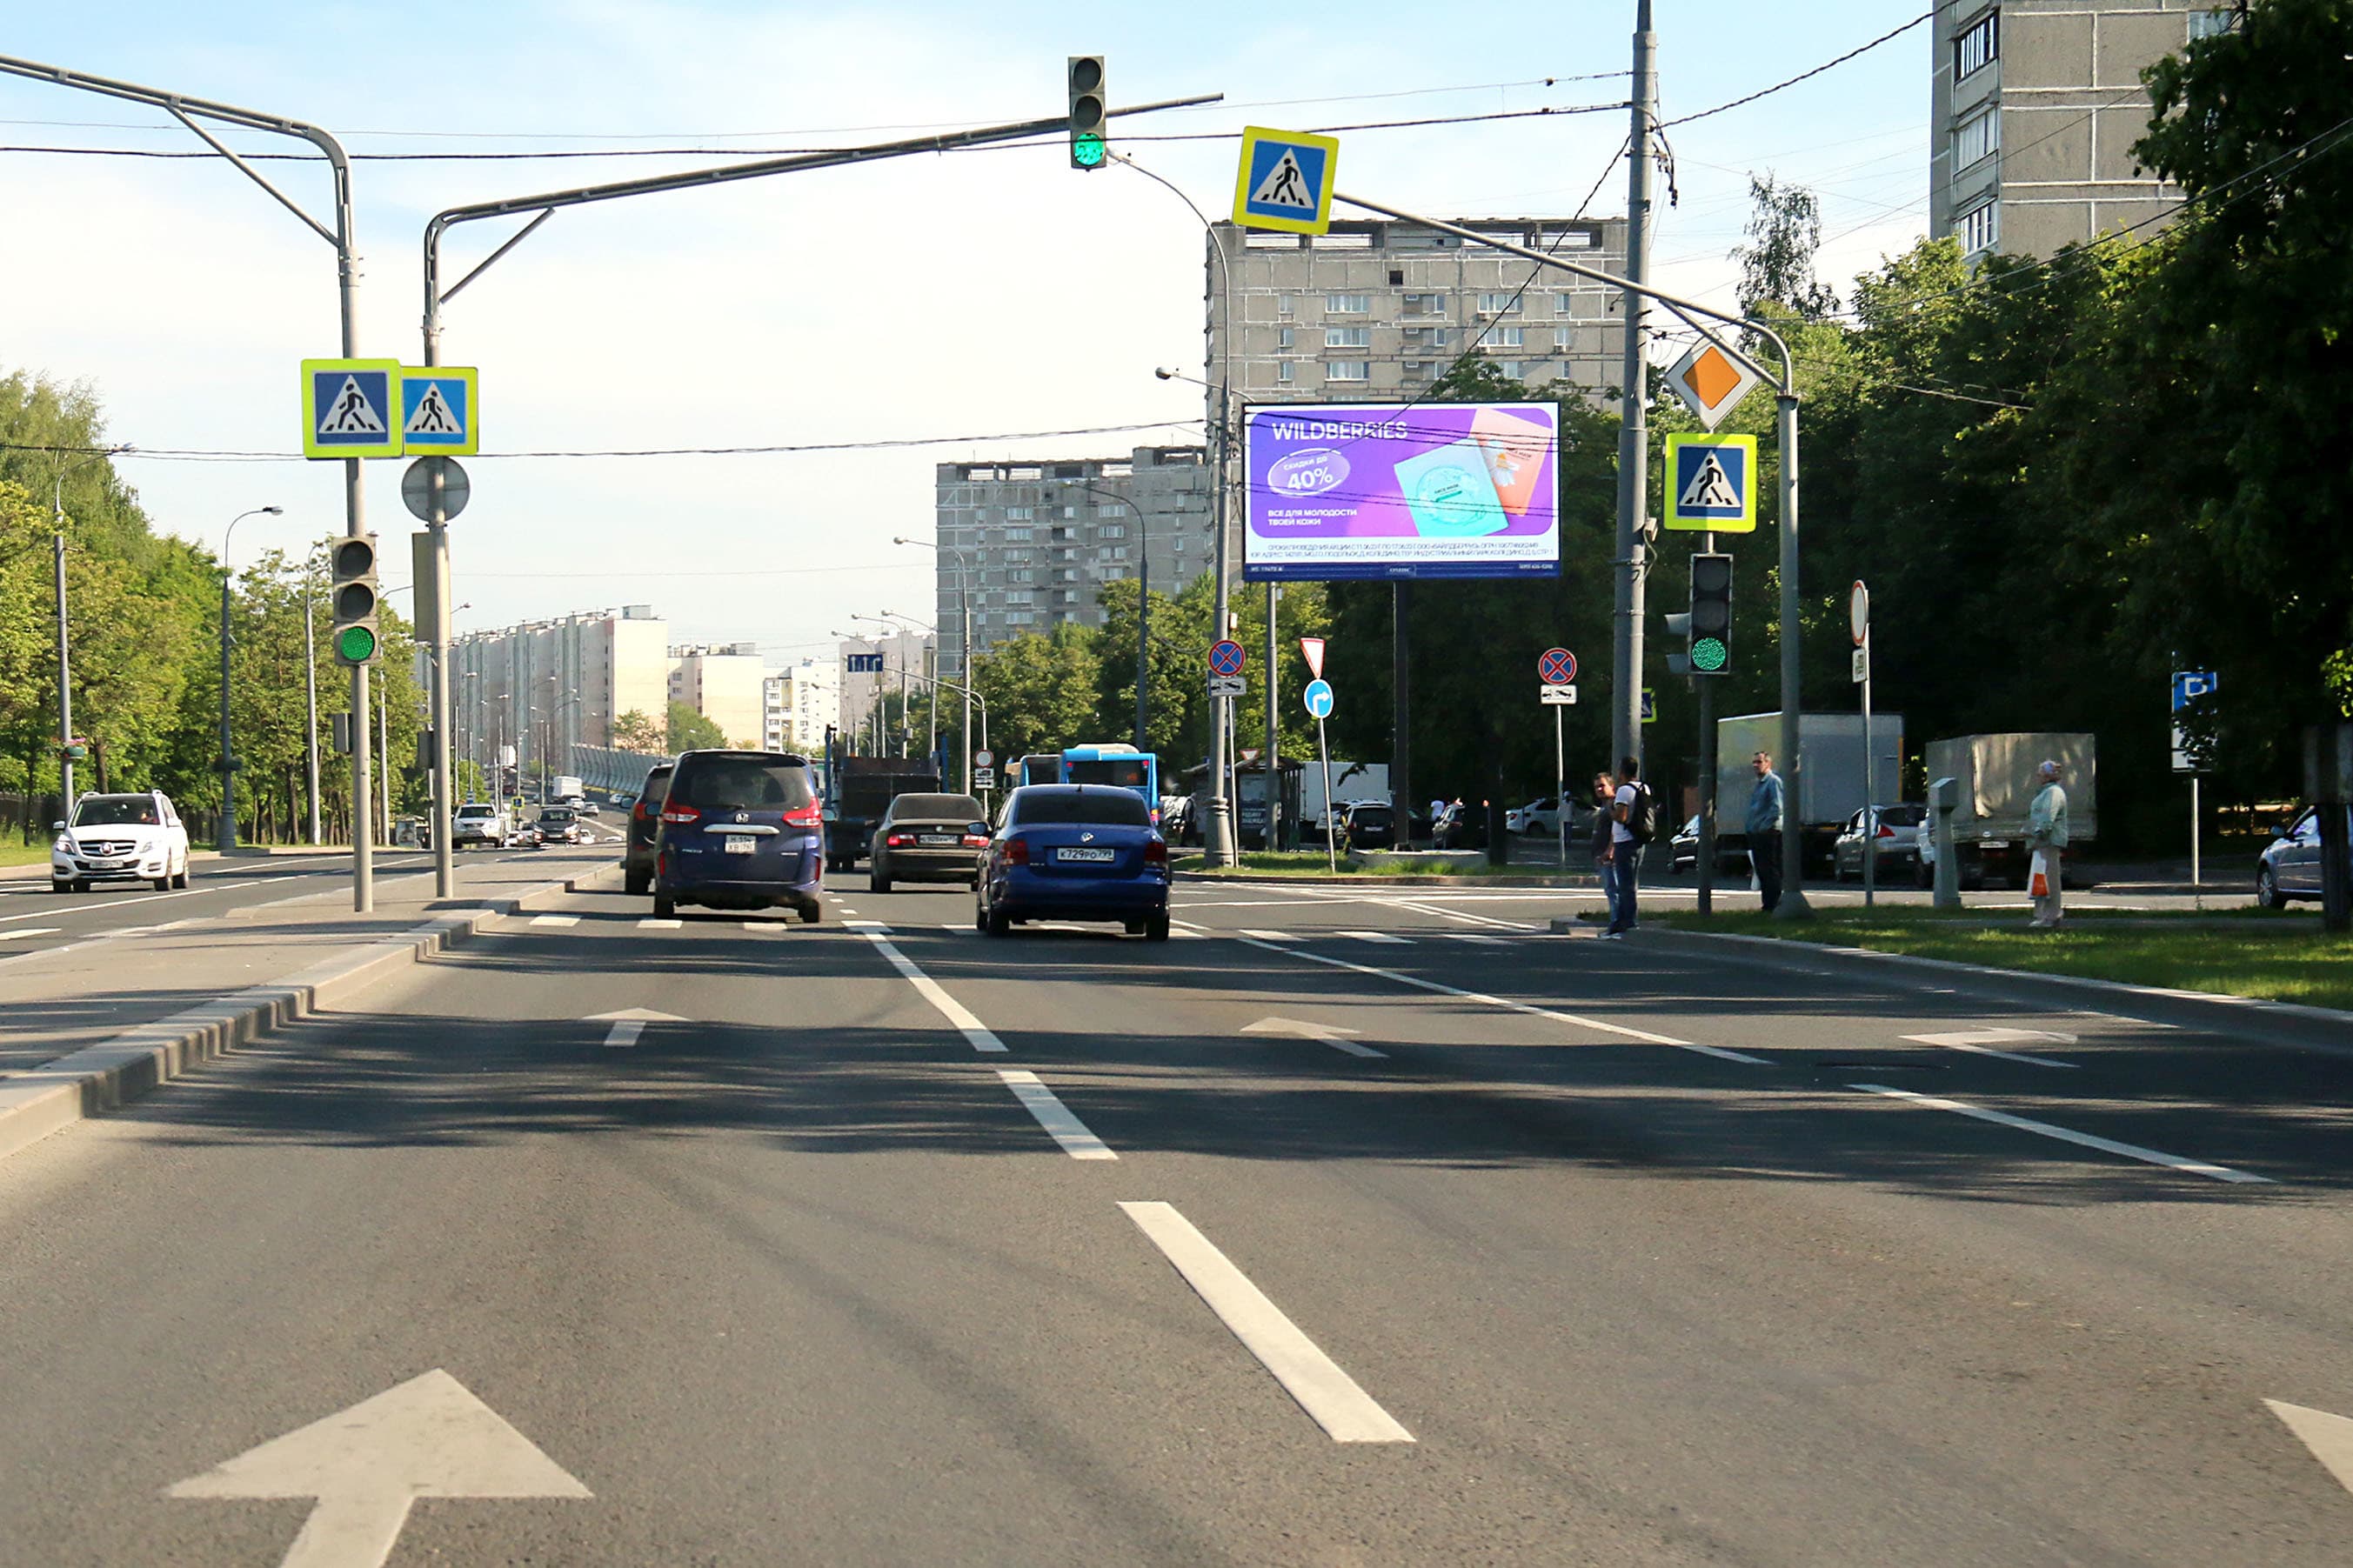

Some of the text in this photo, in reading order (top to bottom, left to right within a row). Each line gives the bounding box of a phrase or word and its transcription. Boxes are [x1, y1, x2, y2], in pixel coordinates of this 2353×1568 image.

[1272, 422, 1408, 440] WILDBERRIES
[1287, 466, 1334, 489] 40%
[1304, 509, 1358, 517] МОЛОДОСТИ
